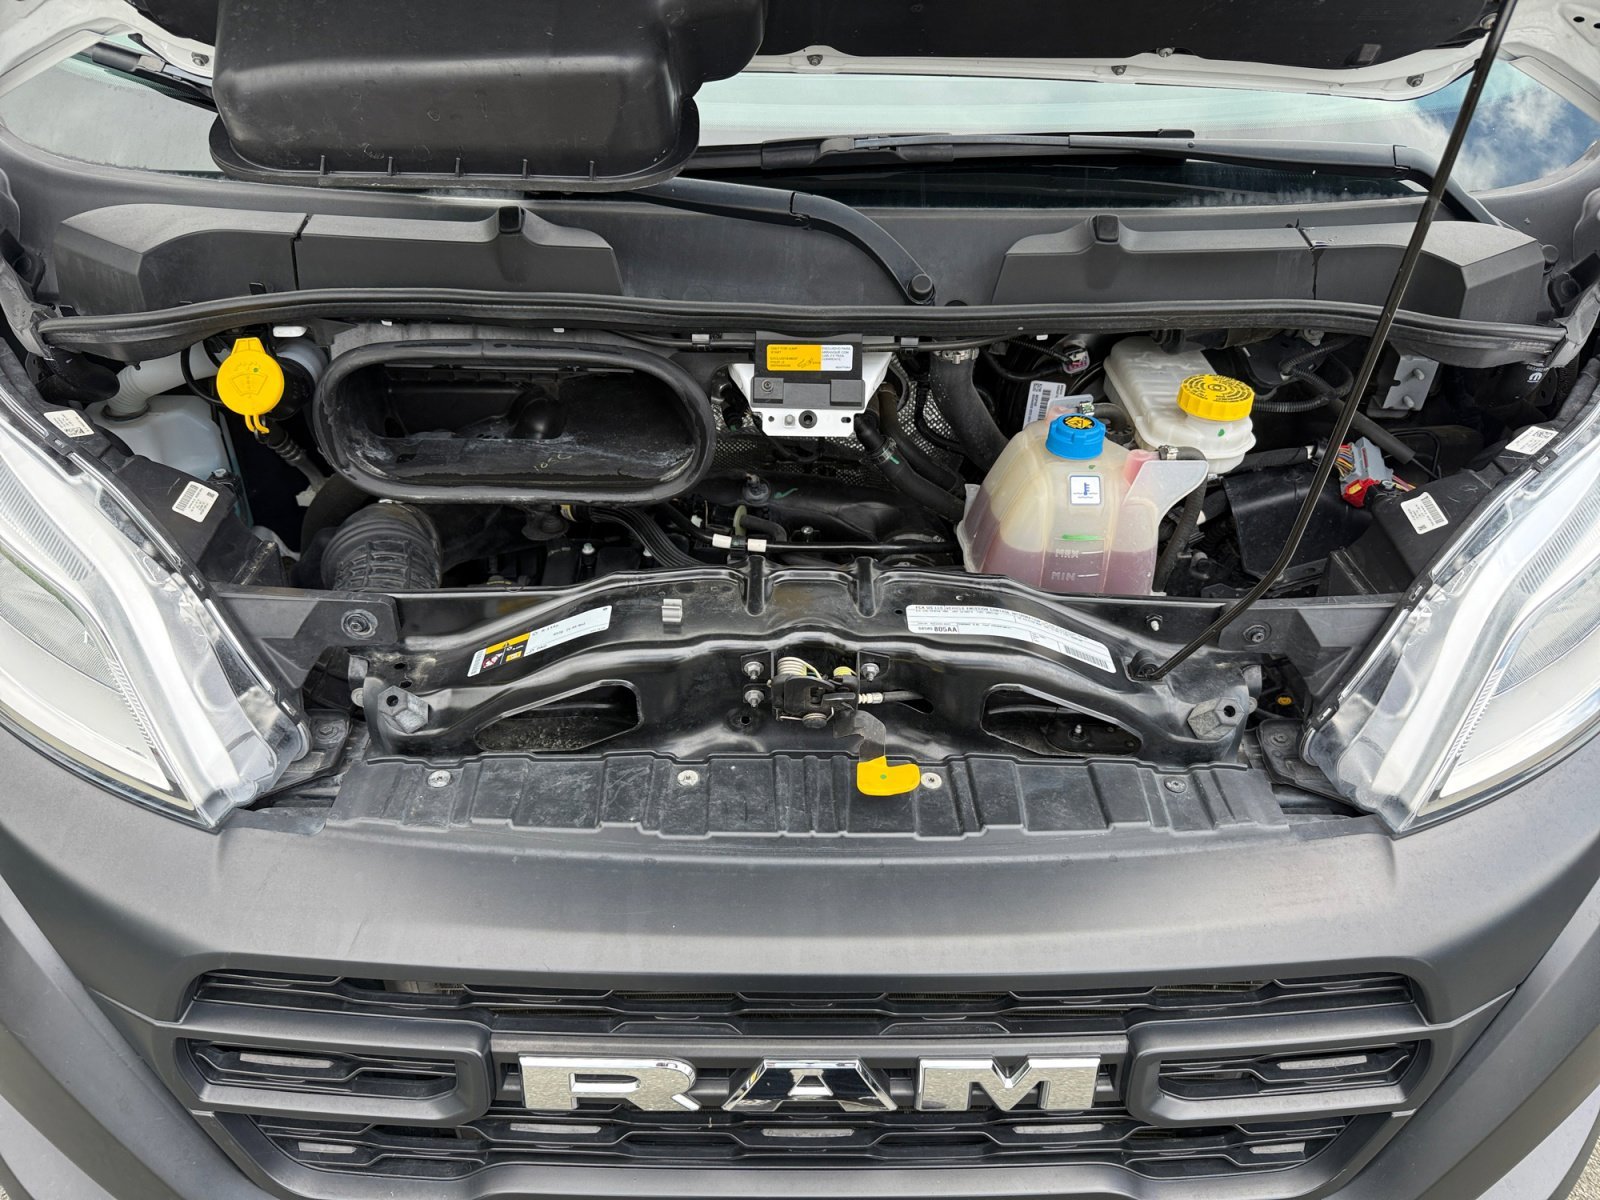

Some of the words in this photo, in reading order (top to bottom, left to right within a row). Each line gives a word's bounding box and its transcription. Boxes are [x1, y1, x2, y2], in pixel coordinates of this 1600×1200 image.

[1055, 548, 1080, 559] MAX
[1051, 571, 1077, 581] MIN
[518, 1054, 1100, 1111] RAM
